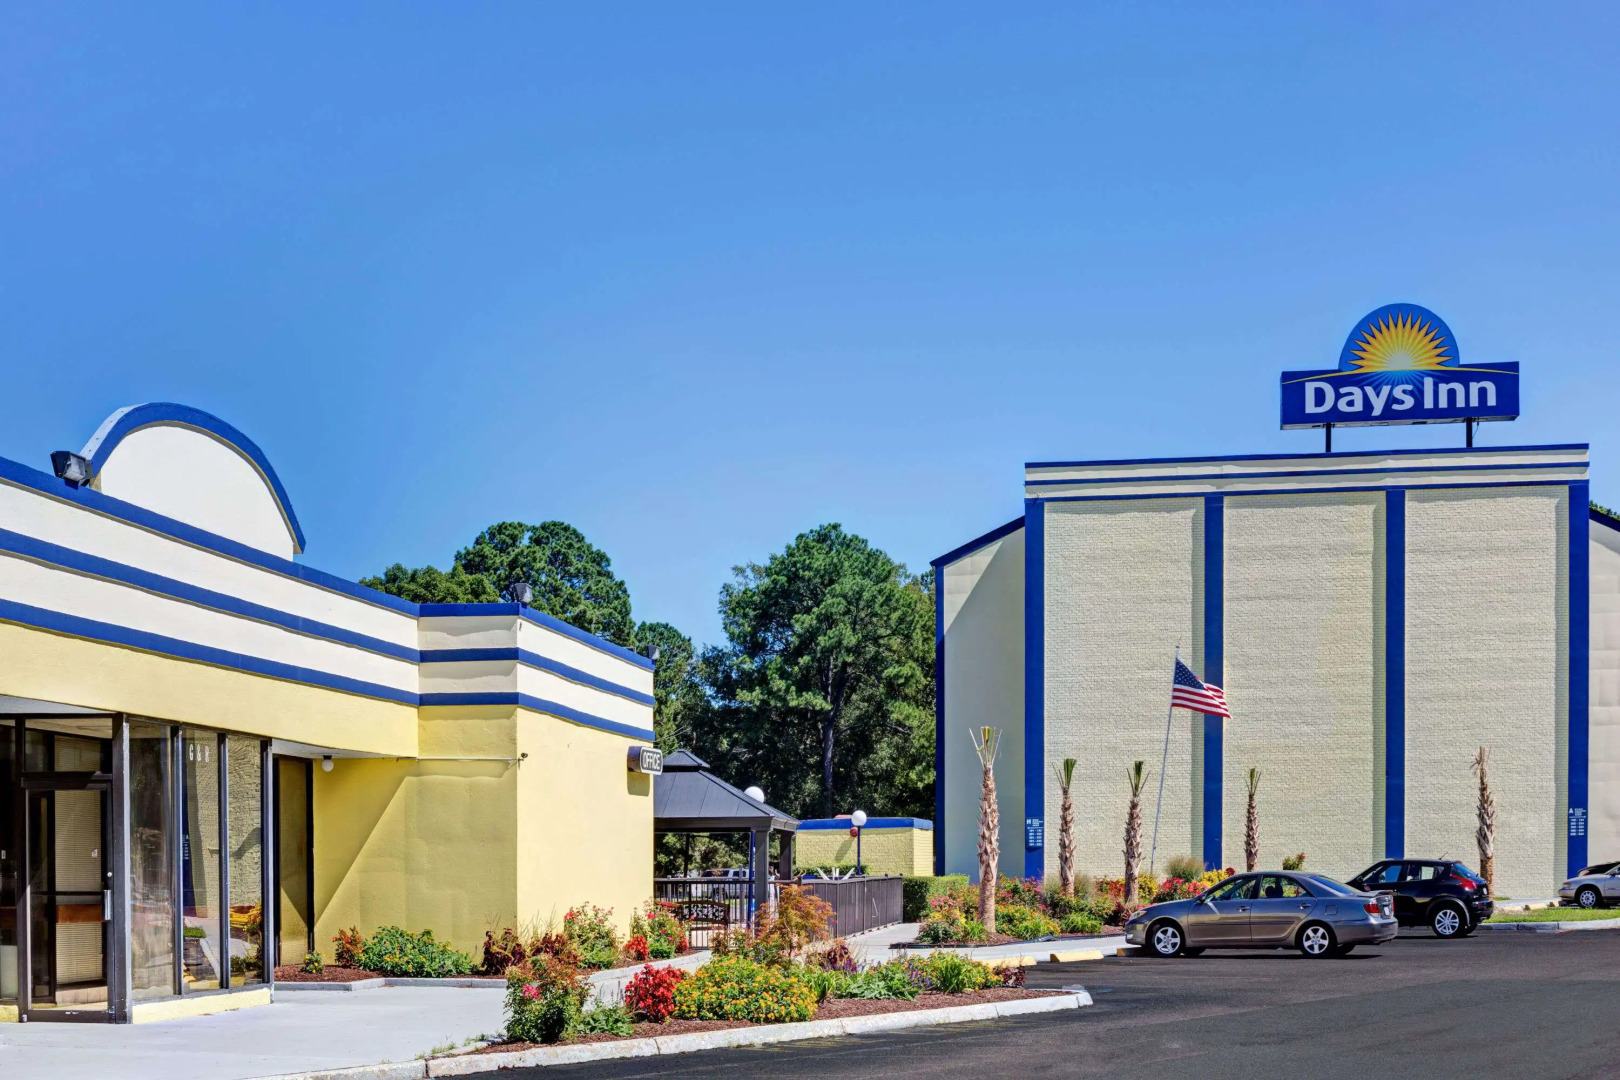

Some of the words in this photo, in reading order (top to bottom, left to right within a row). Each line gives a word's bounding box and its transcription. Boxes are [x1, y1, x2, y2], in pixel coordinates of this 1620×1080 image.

[1305, 381, 1415, 416] Days
[1424, 377, 1497, 409] Inn
[643, 751, 660, 770] OFFICE
